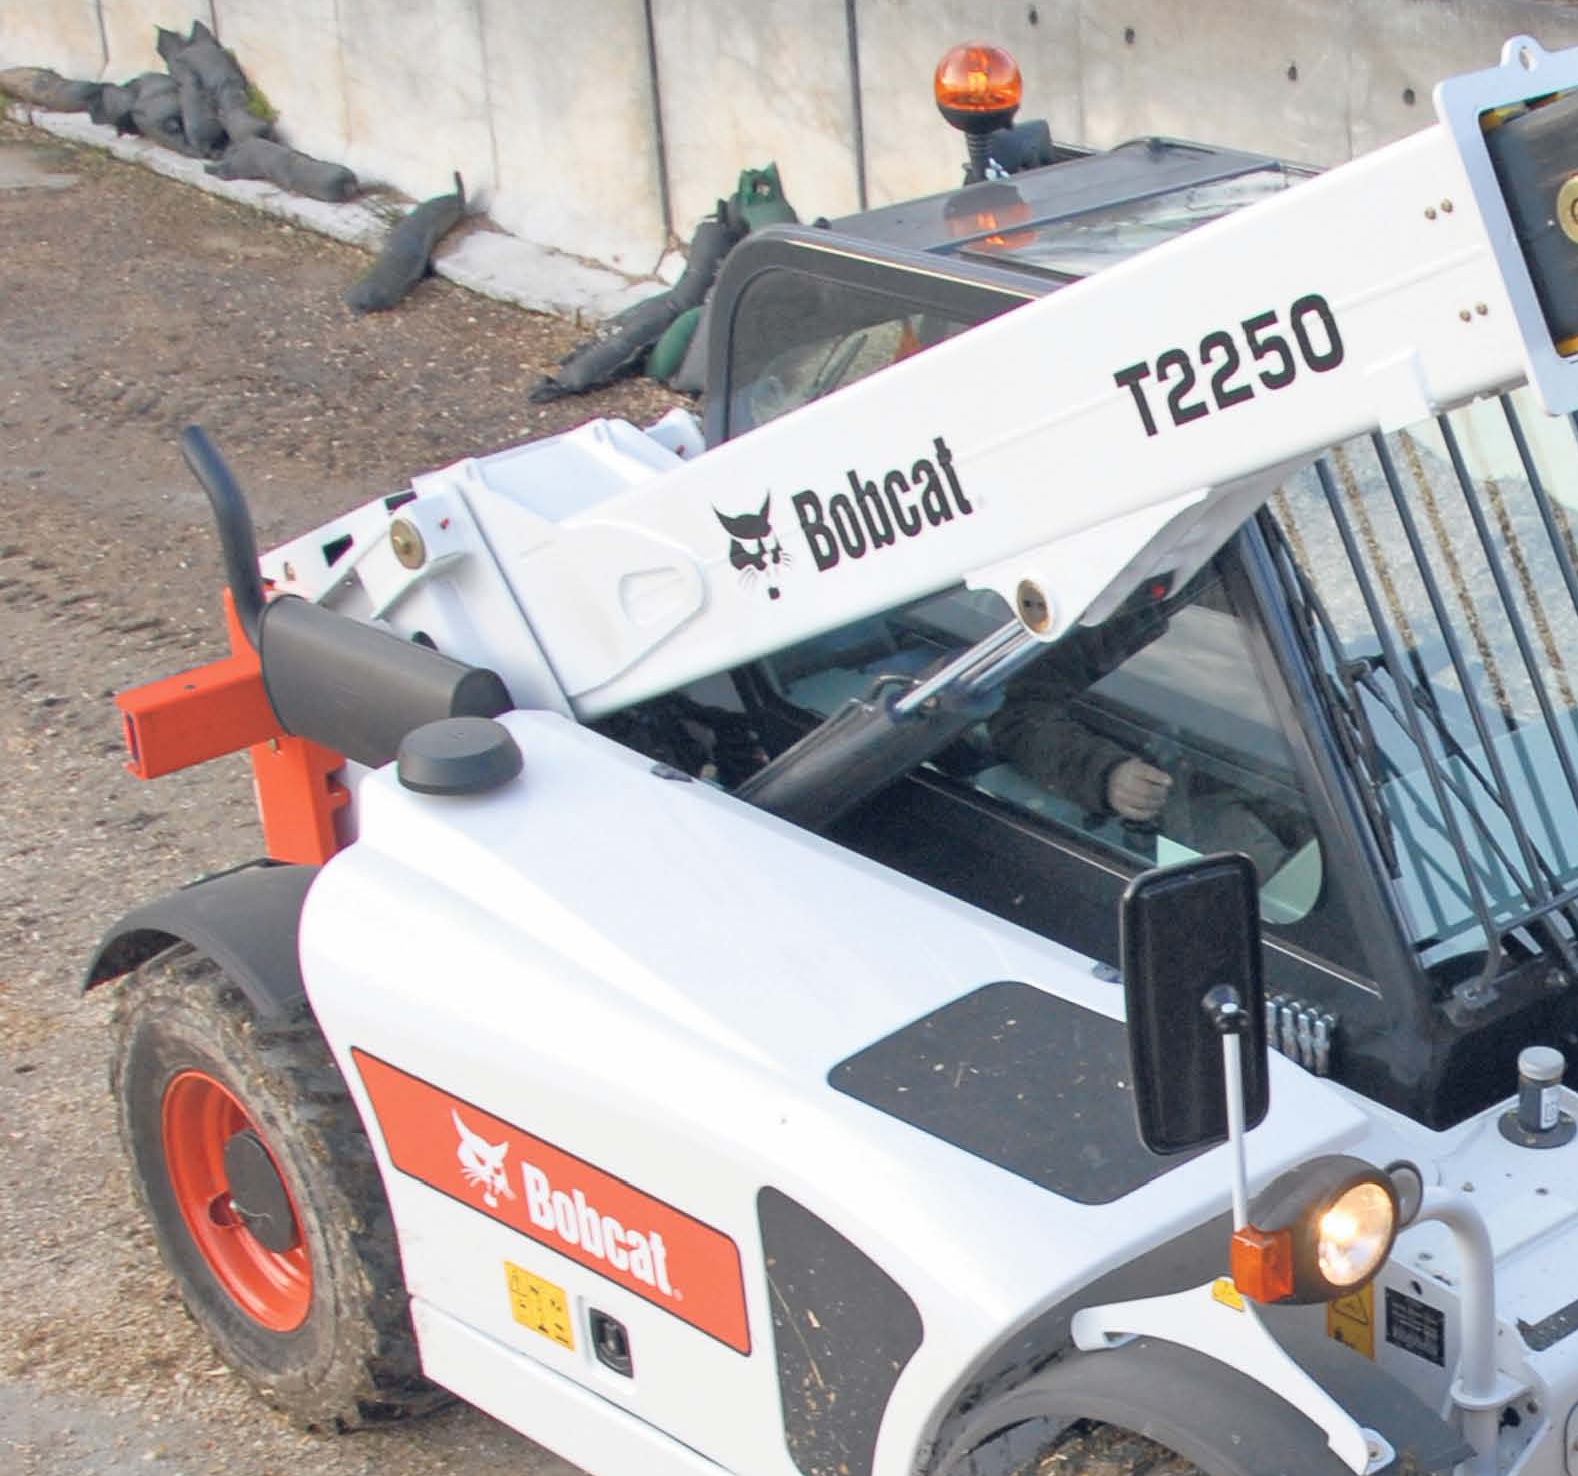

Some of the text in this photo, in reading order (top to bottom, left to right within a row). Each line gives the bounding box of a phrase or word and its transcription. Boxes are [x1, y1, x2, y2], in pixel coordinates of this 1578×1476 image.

[1113, 294, 1344, 437] T2250
[791, 437, 973, 572] Bobcat
[521, 1161, 673, 1296] Bobcat
